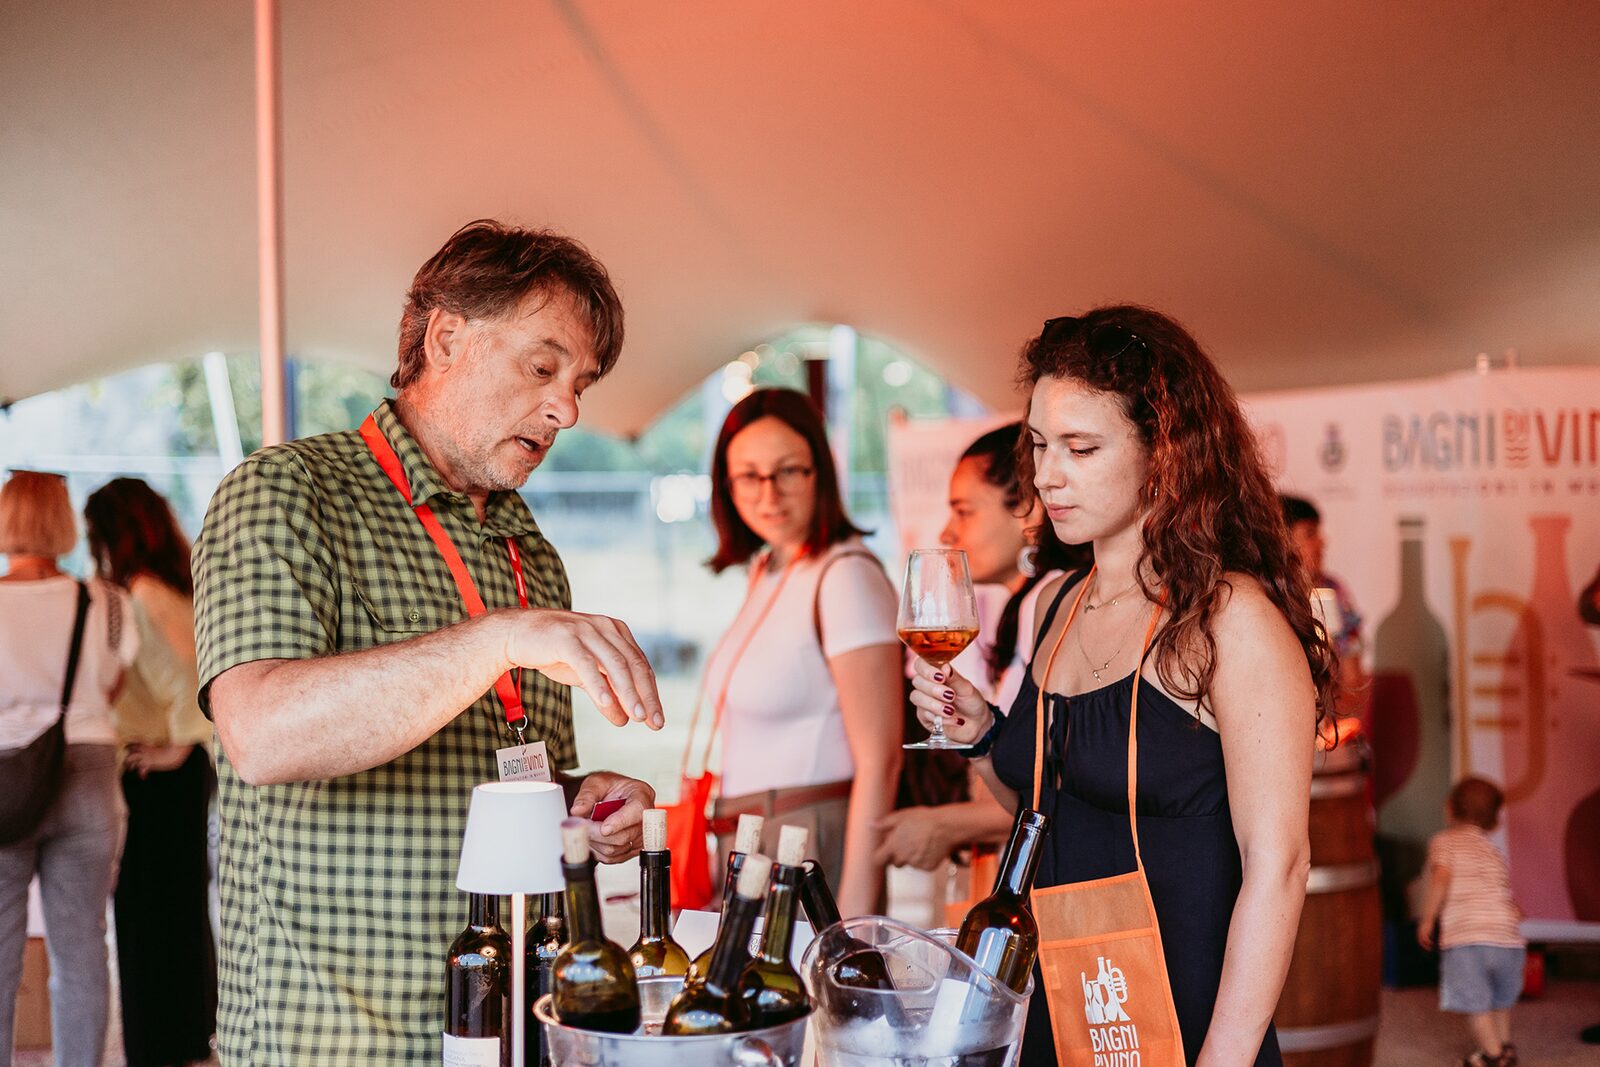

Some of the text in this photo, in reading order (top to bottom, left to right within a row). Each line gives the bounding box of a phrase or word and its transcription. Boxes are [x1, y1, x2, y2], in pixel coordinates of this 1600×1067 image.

[1382, 411, 1495, 471] BAGNI
[503, 758, 524, 776] BAGNI
[527, 754, 544, 770] VINO
[1089, 1024, 1139, 1052] BAGNI
[1094, 1053, 1103, 1067] DI
